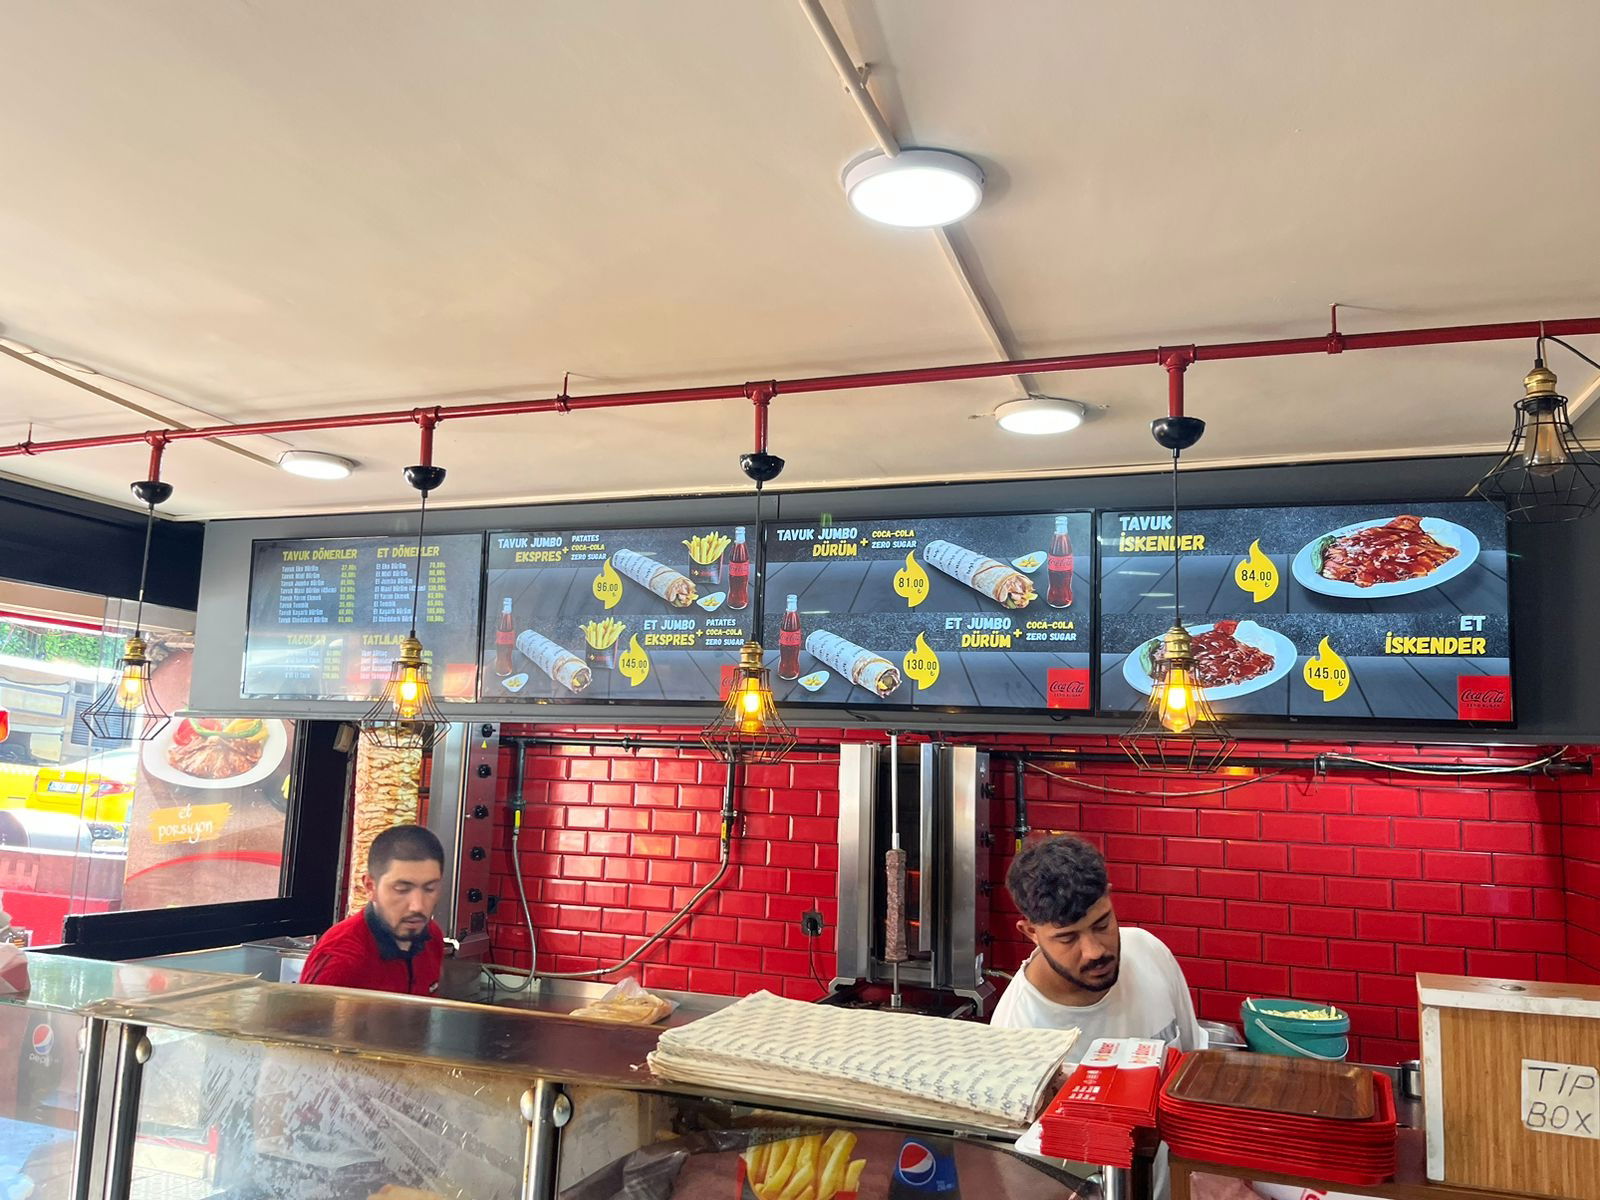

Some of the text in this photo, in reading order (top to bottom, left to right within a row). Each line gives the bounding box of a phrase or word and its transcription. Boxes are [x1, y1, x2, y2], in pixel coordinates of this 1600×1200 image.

[1119, 515, 1173, 531] TAVUK
[777, 527, 858, 541] TAVUK JUMBO
[871, 529, 915, 538] COCA-COLA
[497, 536, 562, 549] TAVUK JUMBO
[571, 543, 605, 551] COCA-COLA
[871, 540, 917, 549] ZERO SUGAR
[1118, 532, 1205, 552] İSKENDER
[376, 547, 390, 558] ET
[812, 541, 857, 557] DÜRÜM
[282, 551, 310, 561] TAVUK
[515, 551, 562, 563] EKSPRES
[570, 553, 586, 561] ZERO
[1240, 569, 1272, 582] 84.00
[596, 582, 618, 592] 96.00
[898, 577, 924, 588] 81.00
[644, 619, 695, 631] ET JUMBO
[706, 619, 736, 627] PATATES
[945, 617, 1011, 630] ET JUMBO
[1026, 620, 1074, 630] COCA-COLA
[1459, 615, 1486, 632] ET
[705, 628, 743, 636] COCA-COLA
[1026, 632, 1077, 641] ZERO SUGAR
[644, 633, 695, 646] EKSPRES
[705, 638, 745, 646] ZERO SUGAR
[961, 631, 1011, 648] DÜRÜM
[1385, 631, 1487, 655] İSKENDER
[621, 658, 648, 669] 145.00
[906, 659, 937, 671] 130.00
[1307, 666, 1347, 680] 145.00
[178, 802, 192, 819] et
[159, 820, 213, 844] porsiyon
[1526, 1101, 1593, 1134] BOX
